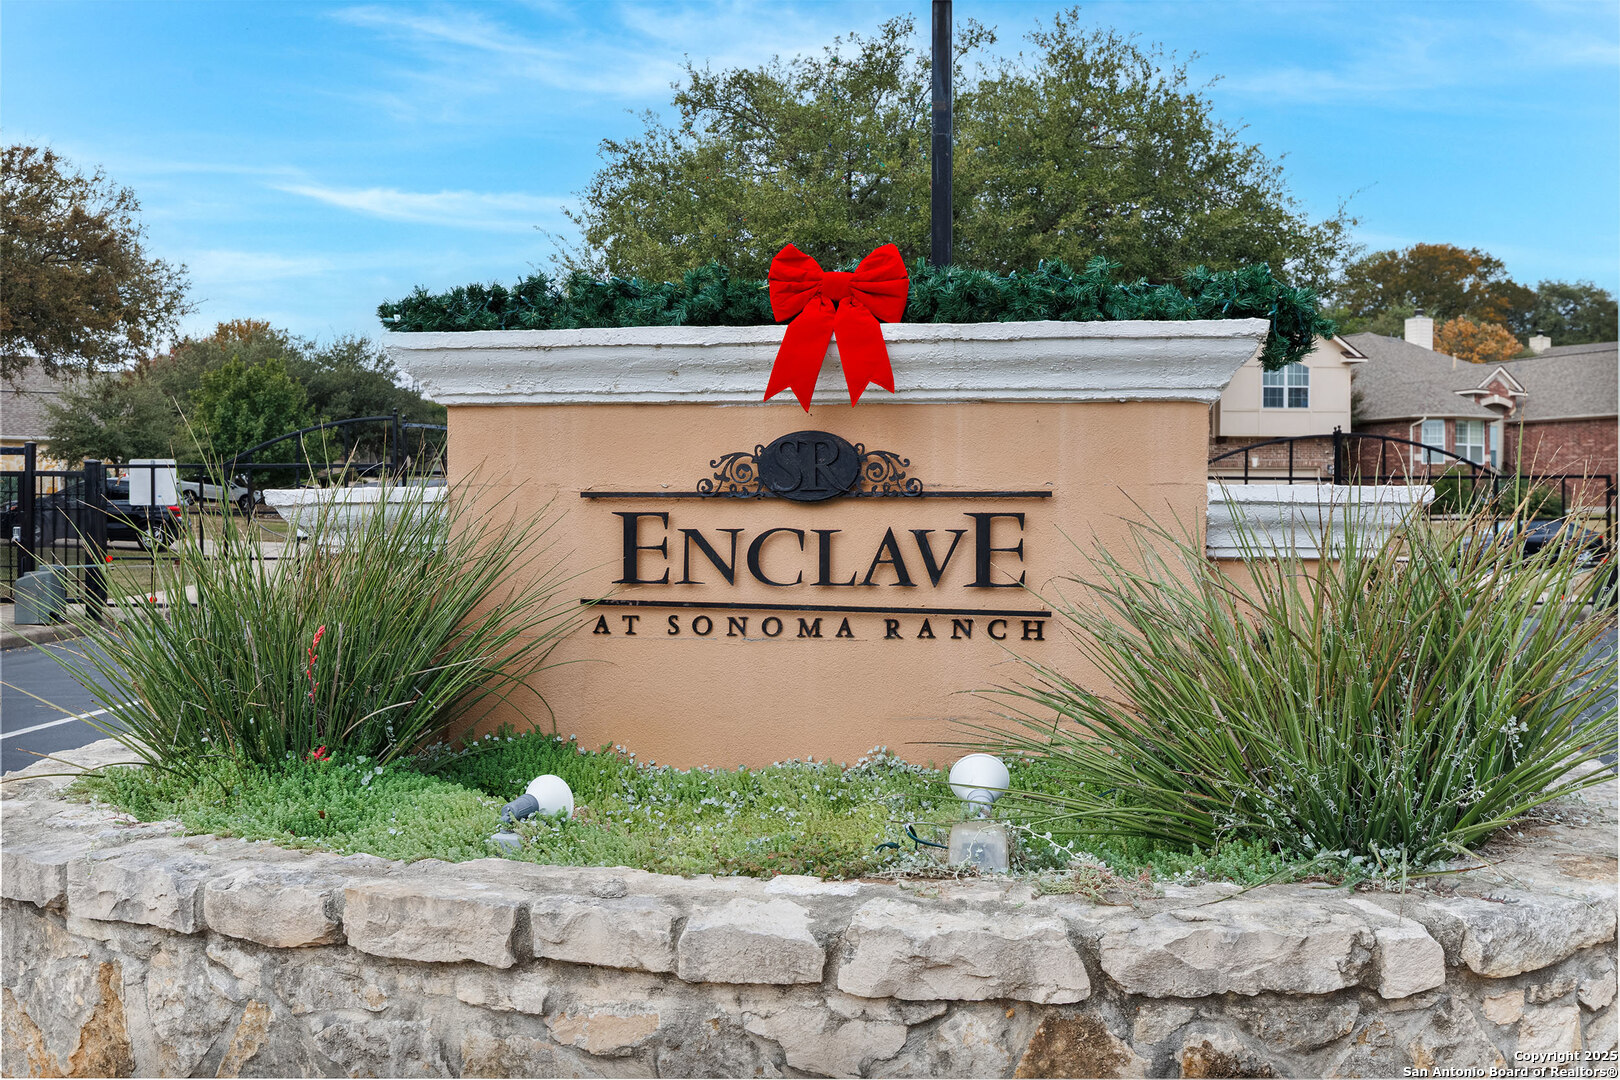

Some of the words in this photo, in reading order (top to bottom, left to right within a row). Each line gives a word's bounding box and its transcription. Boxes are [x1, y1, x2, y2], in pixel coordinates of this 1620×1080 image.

[774, 440, 850, 492] SR
[611, 511, 1026, 588] ENCLAVE
[592, 614, 640, 635] AT
[668, 614, 855, 639] SONOMA
[883, 618, 1046, 641] RANCH
